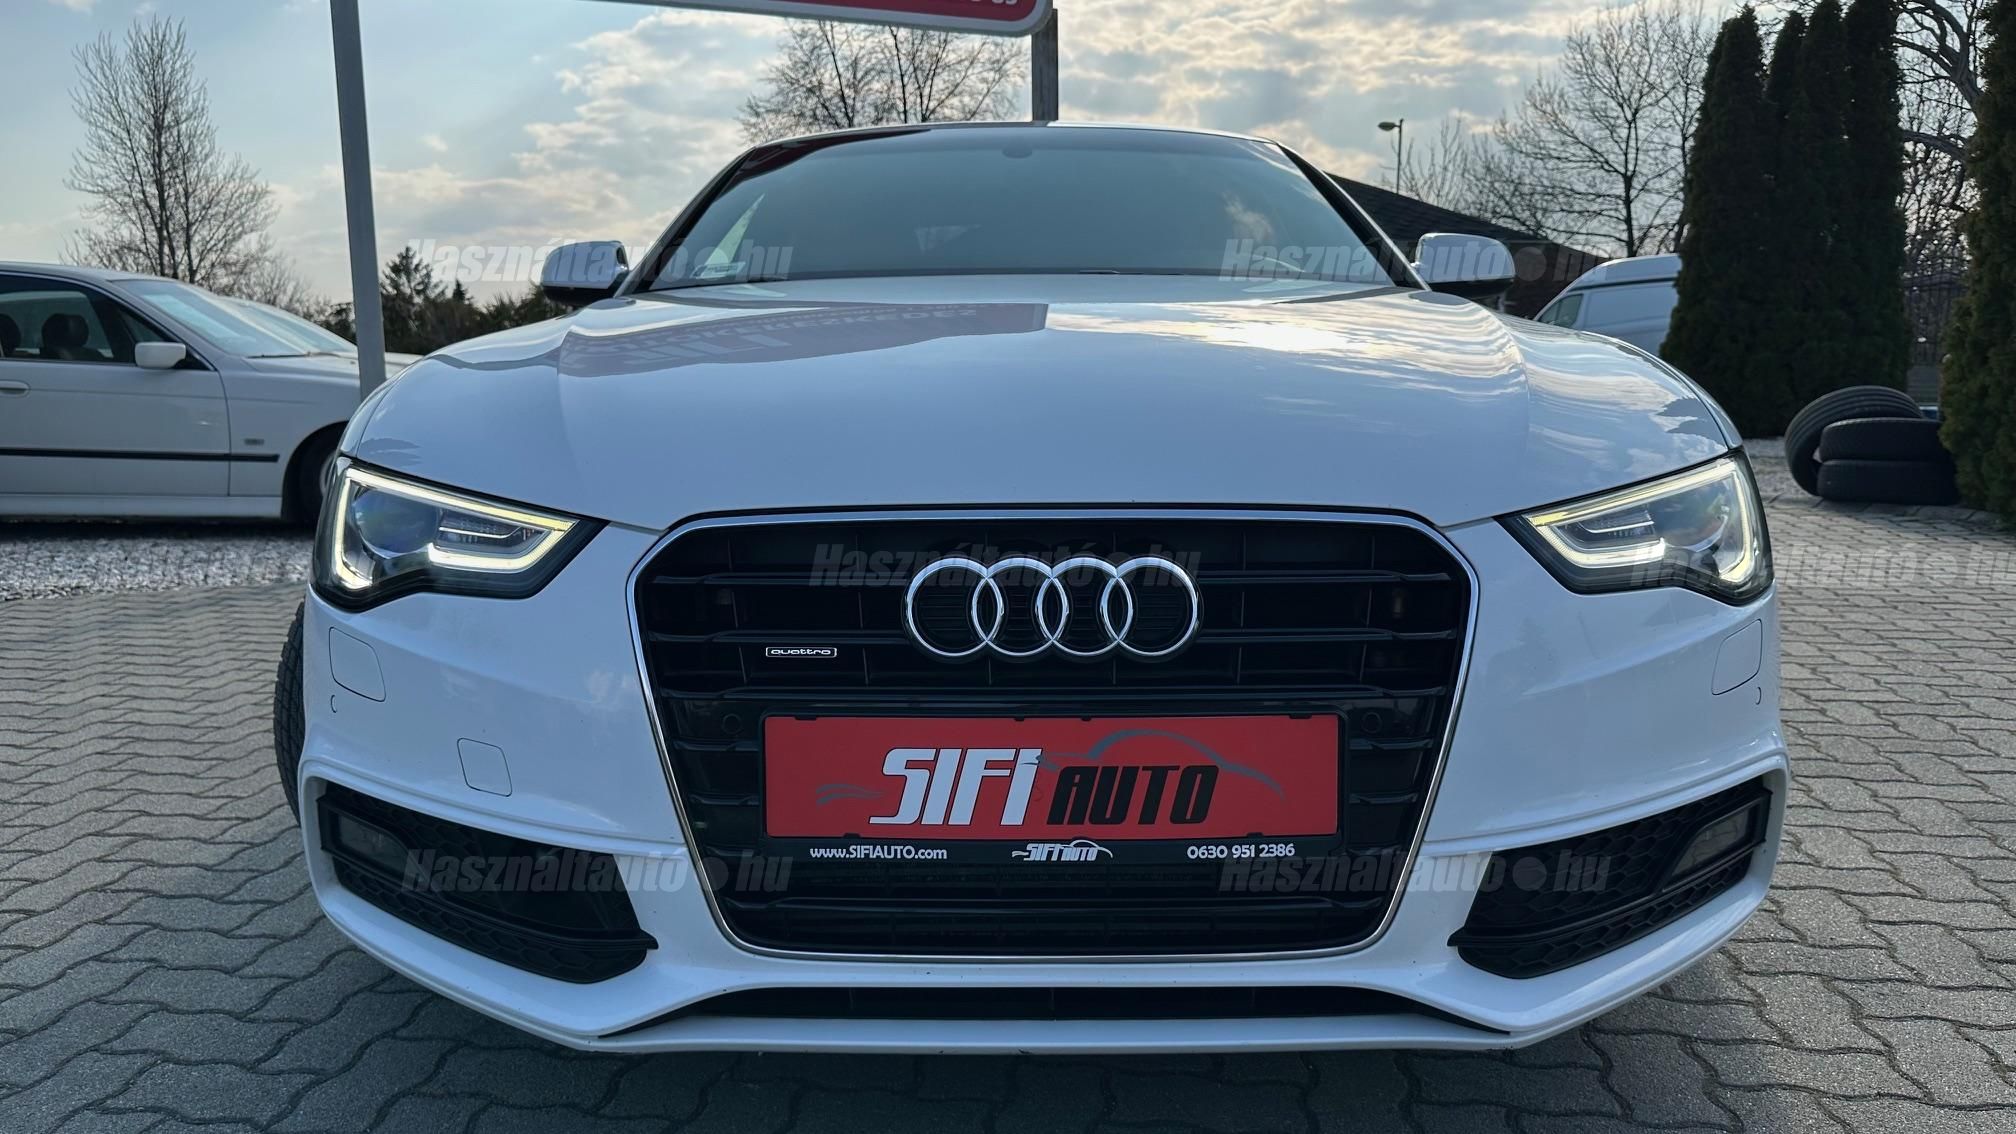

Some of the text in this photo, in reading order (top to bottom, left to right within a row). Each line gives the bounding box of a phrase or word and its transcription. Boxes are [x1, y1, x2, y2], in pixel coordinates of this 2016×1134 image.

[769, 647, 832, 657] quattro
[868, 747, 1219, 826] SIFI AUTO
[809, 845, 948, 860] www.SIFIAUTO.com
[1186, 842, 1296, 860] 0630 951 2386
